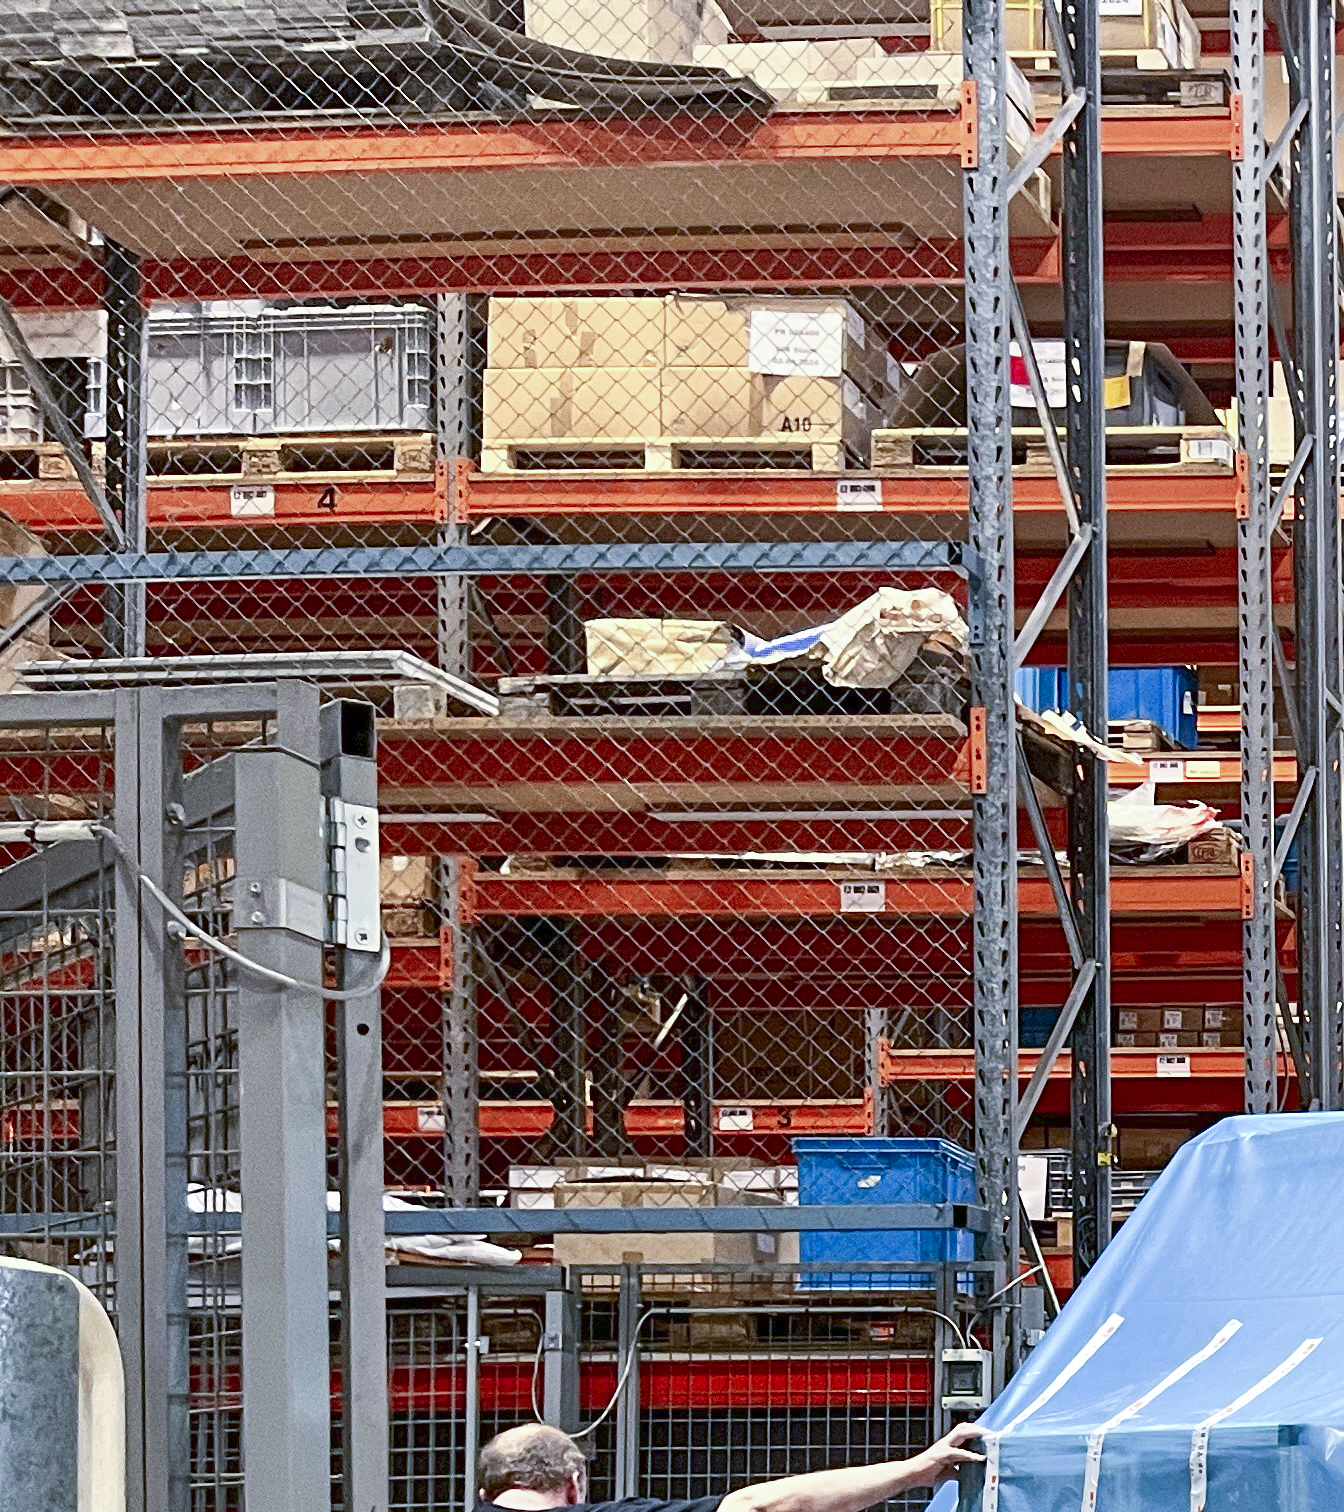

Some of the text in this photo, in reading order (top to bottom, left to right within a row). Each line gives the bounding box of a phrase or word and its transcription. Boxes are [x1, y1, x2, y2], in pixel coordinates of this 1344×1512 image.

[781, 416, 812, 432] A10
[318, 488, 337, 513] 4
[777, 1106, 792, 1128] 3
